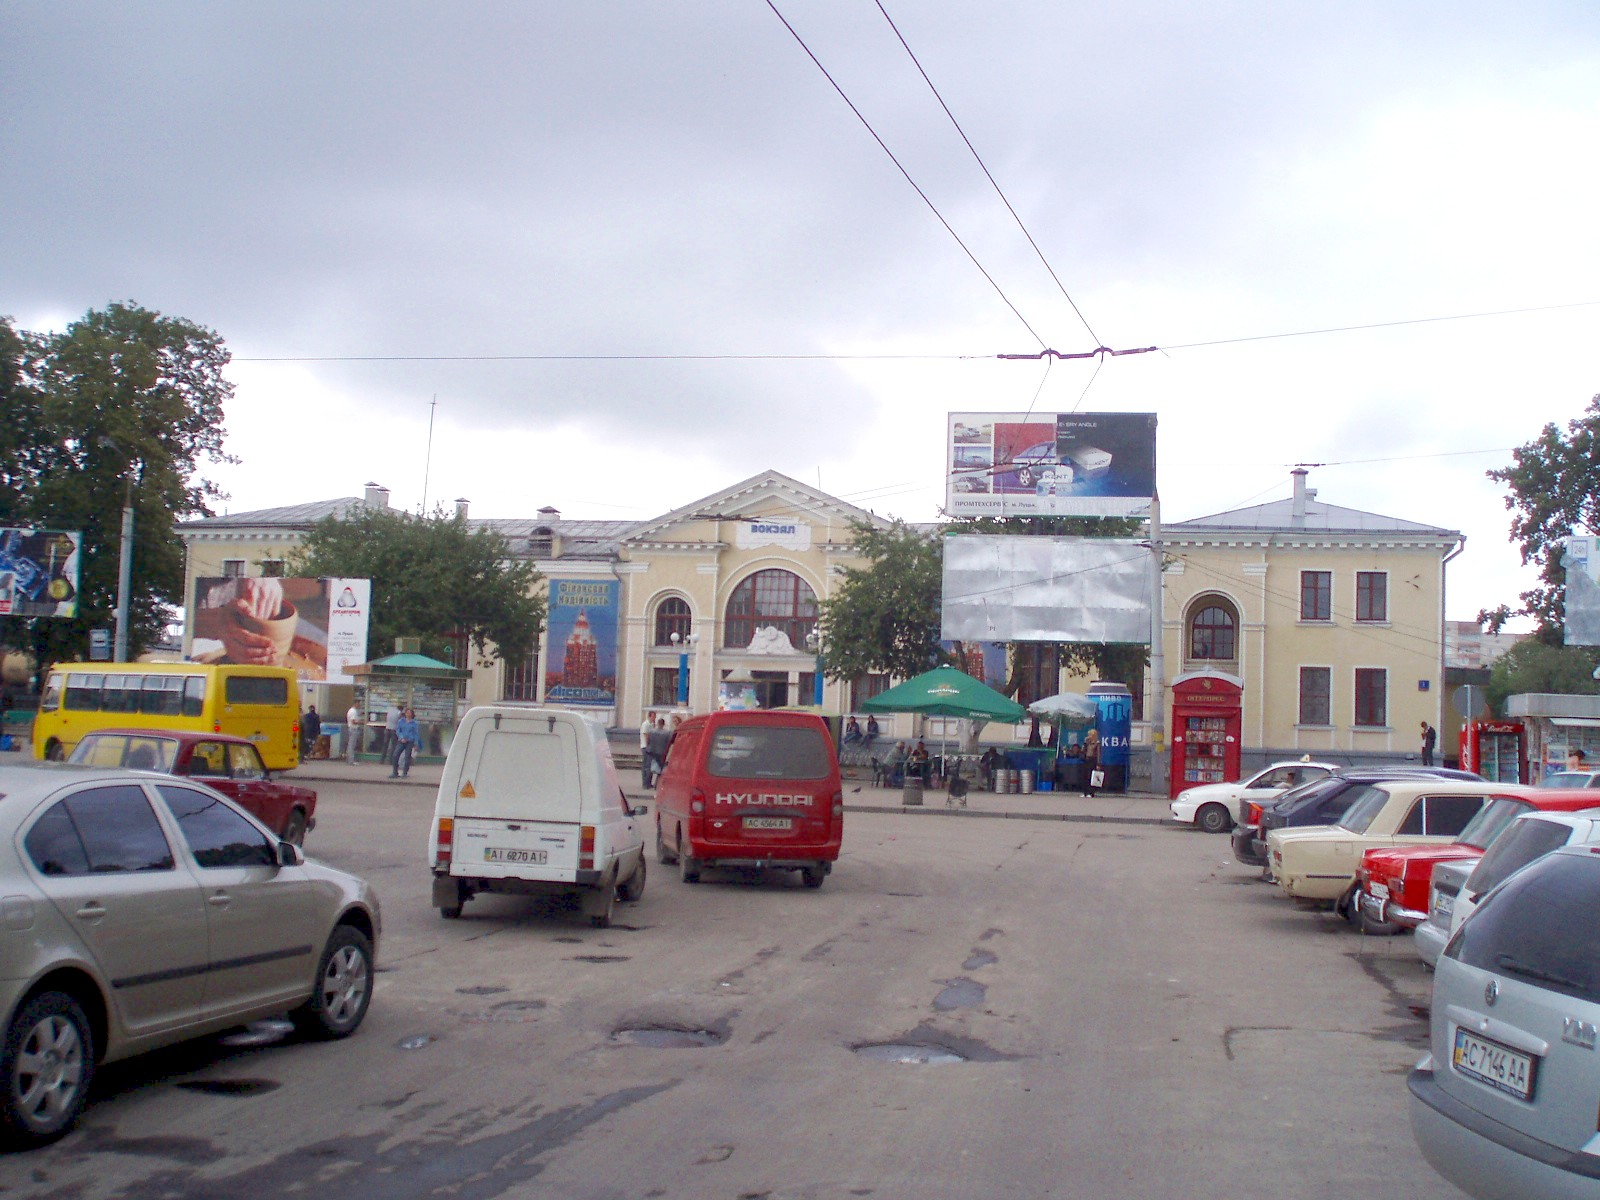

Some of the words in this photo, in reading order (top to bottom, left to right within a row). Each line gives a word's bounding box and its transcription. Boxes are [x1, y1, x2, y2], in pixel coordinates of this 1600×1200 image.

[751, 524, 795, 534] ВОКЗАЛ
[715, 793, 813, 806] HYUNDAI
[506, 851, 528, 861] 6270
[1461, 1039, 1477, 1067] AC
[1479, 1045, 1505, 1079] 7146
[1507, 1057, 1525, 1088] AA
